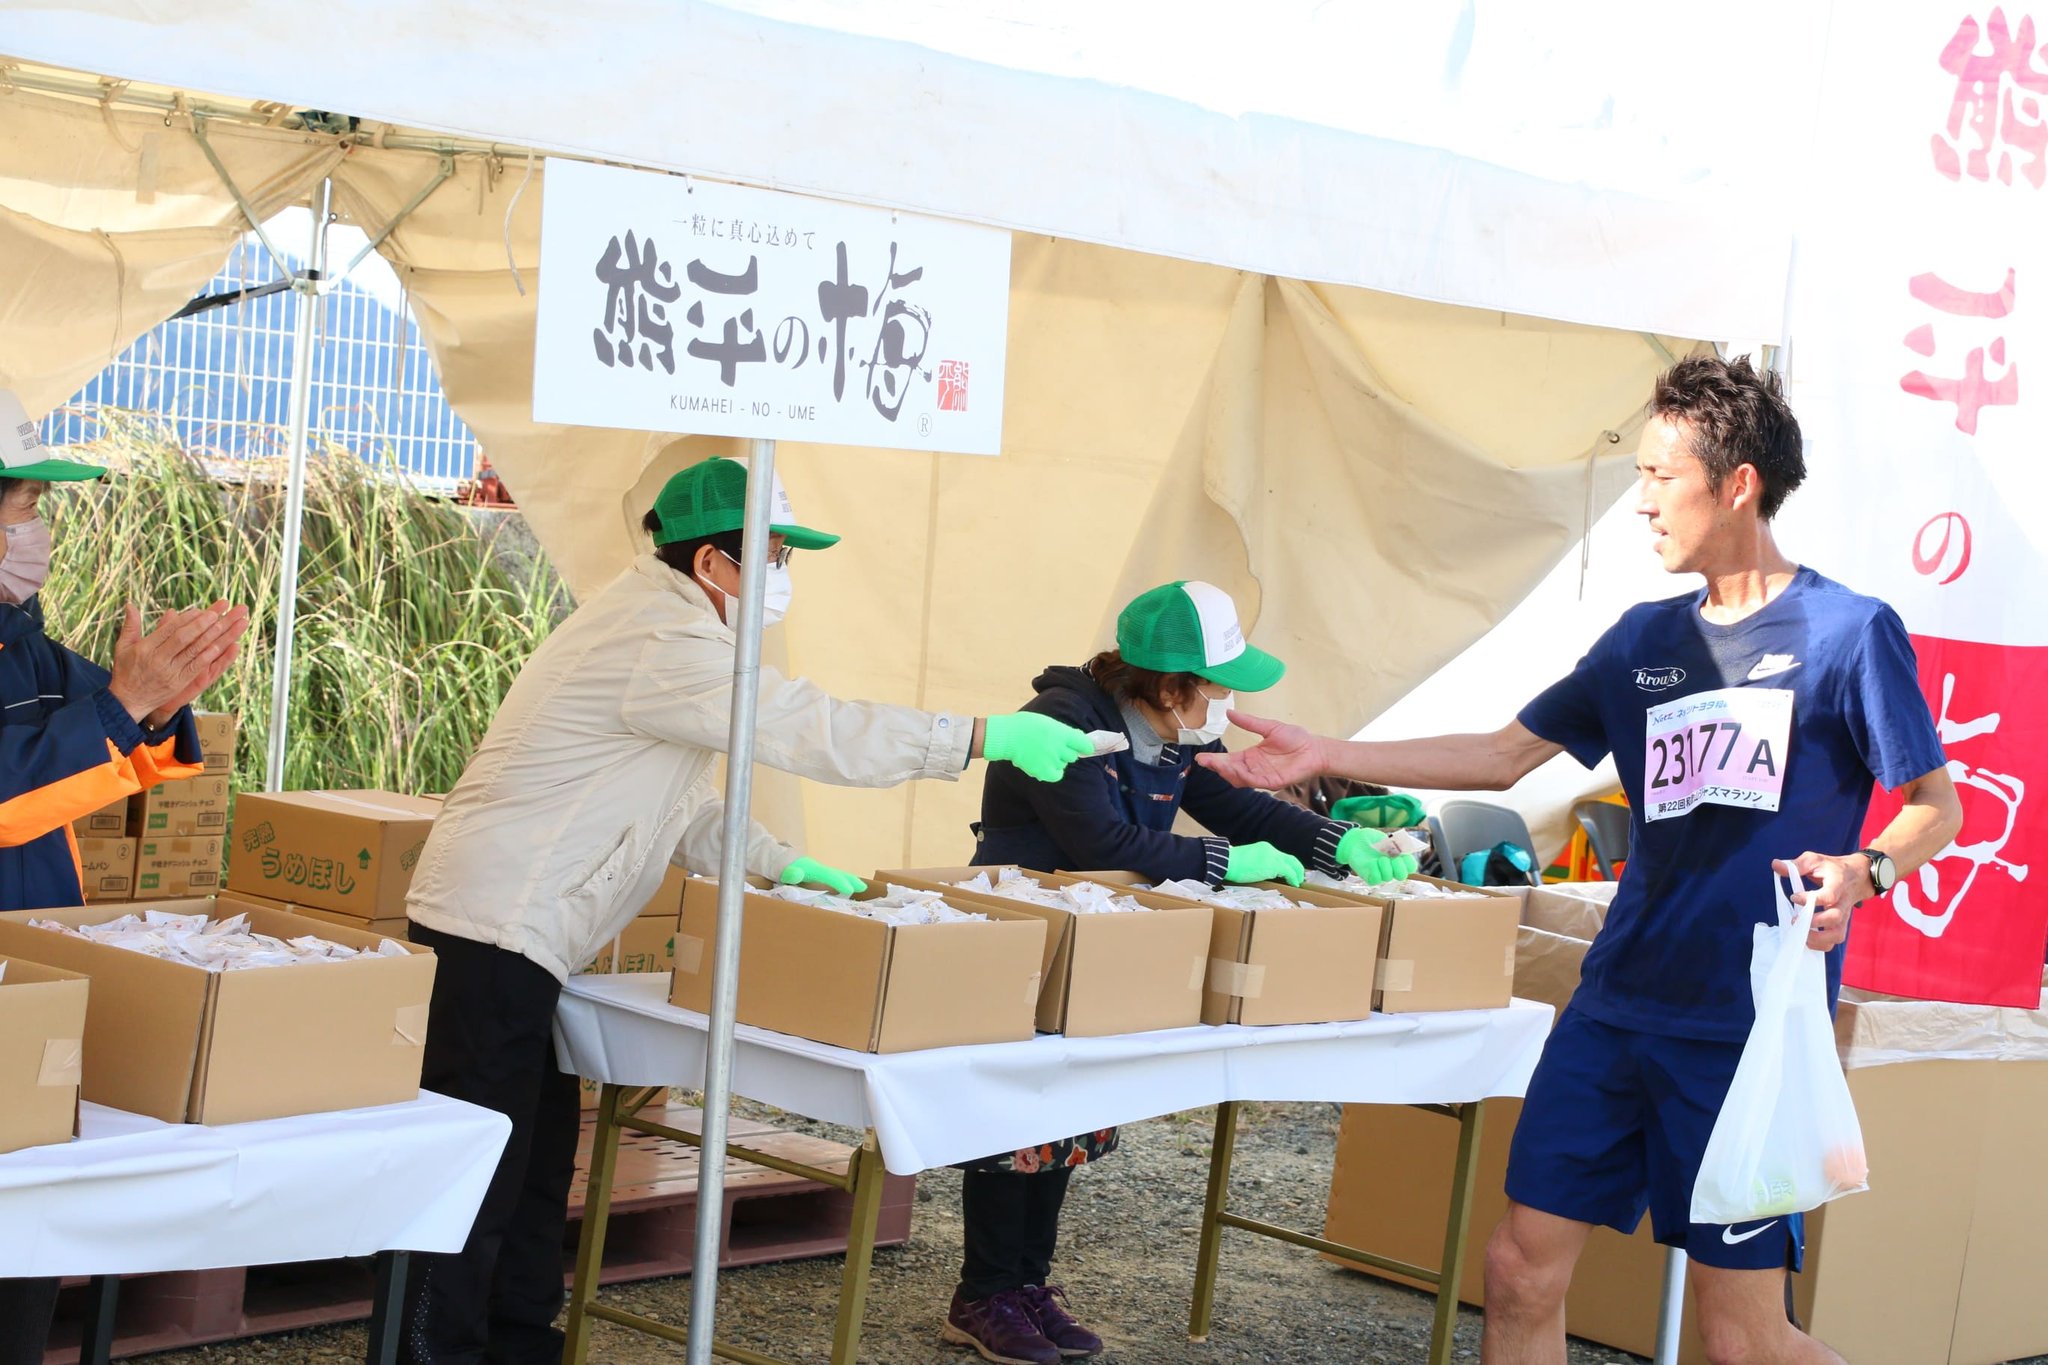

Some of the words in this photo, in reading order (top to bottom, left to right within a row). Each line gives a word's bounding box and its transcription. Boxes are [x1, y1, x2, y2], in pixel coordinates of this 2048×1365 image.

[672, 213, 816, 250] 一粒に真心込めて
[593, 228, 933, 422] 熊平の梅
[670, 394, 733, 414] KUMAHEI
[752, 401, 771, 417] NO
[788, 404, 816, 421] UME
[1651, 722, 1742, 789] 23177
[1746, 739, 1776, 777] A
[261, 847, 356, 895] うめぼし
